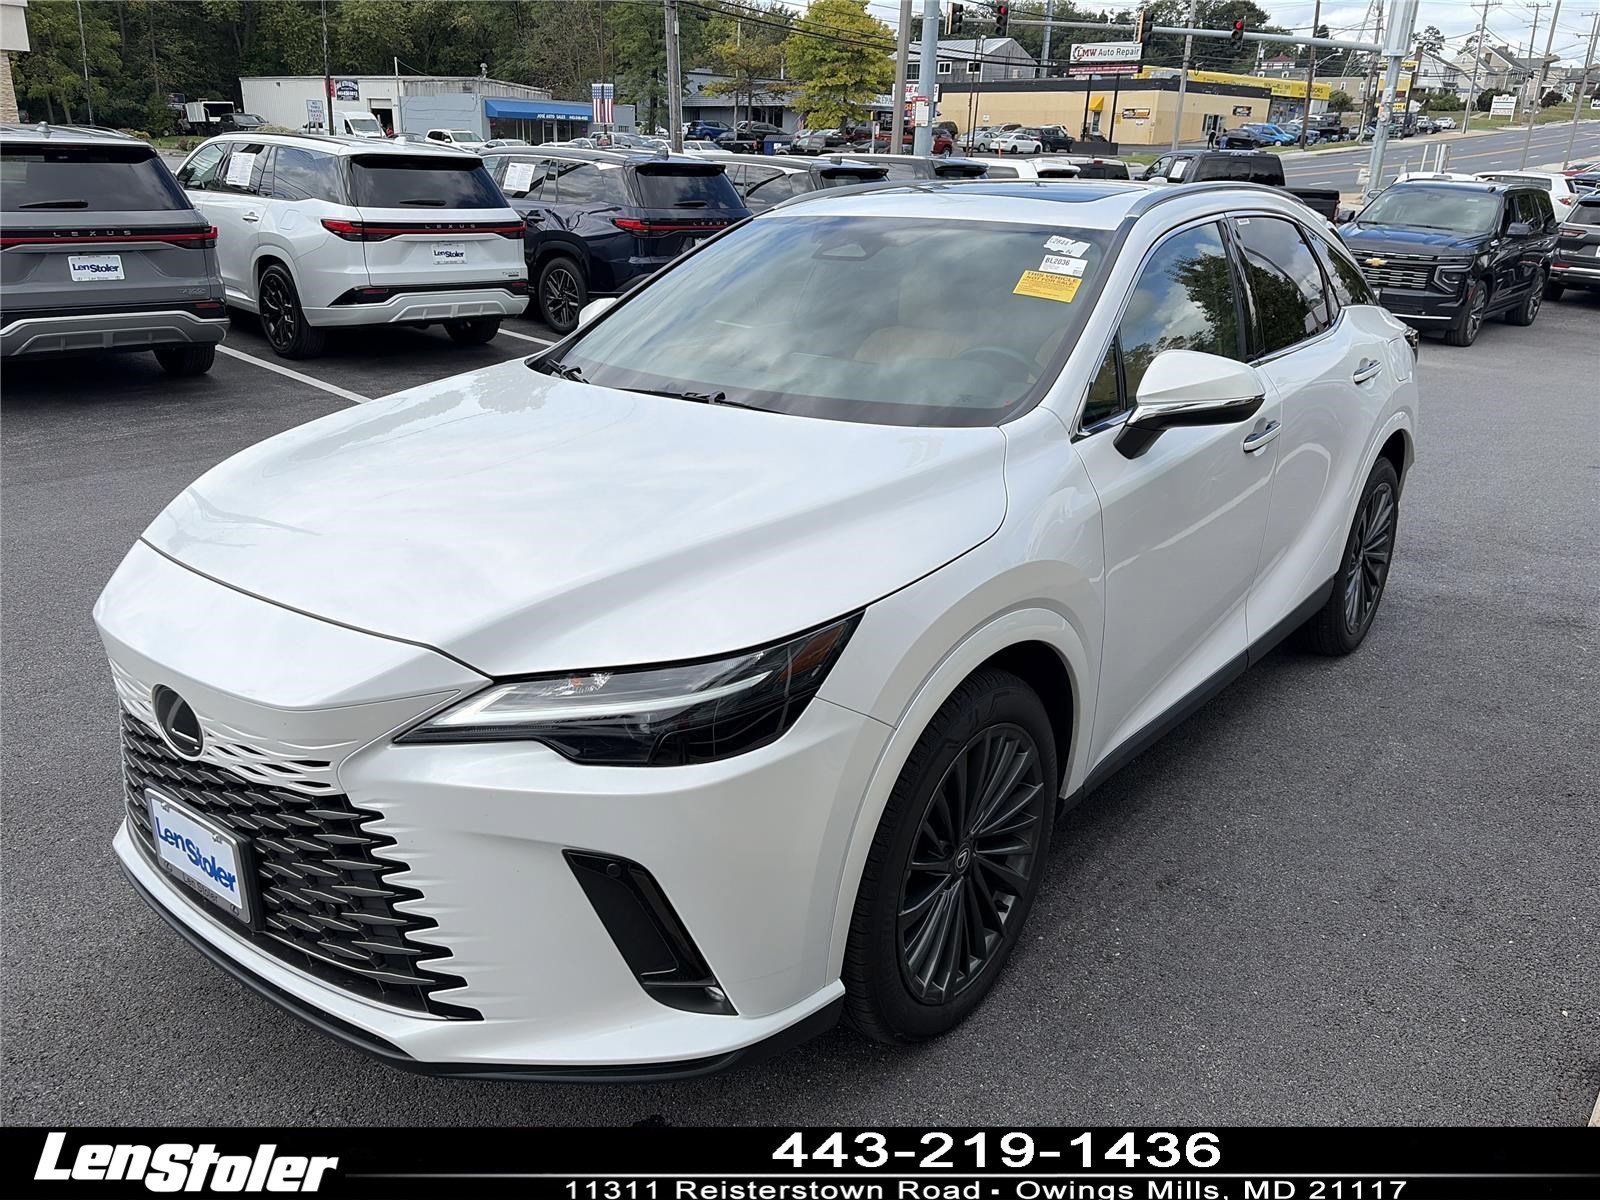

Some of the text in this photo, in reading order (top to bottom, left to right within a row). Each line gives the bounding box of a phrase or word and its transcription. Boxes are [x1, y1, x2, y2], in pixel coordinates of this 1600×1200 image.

[1077, 47, 1140, 57] LMW Auto Repair
[53, 230, 132, 238] LEXUS
[1045, 257, 1071, 266] BL2036
[1045, 274, 1077, 283] VEHICLE
